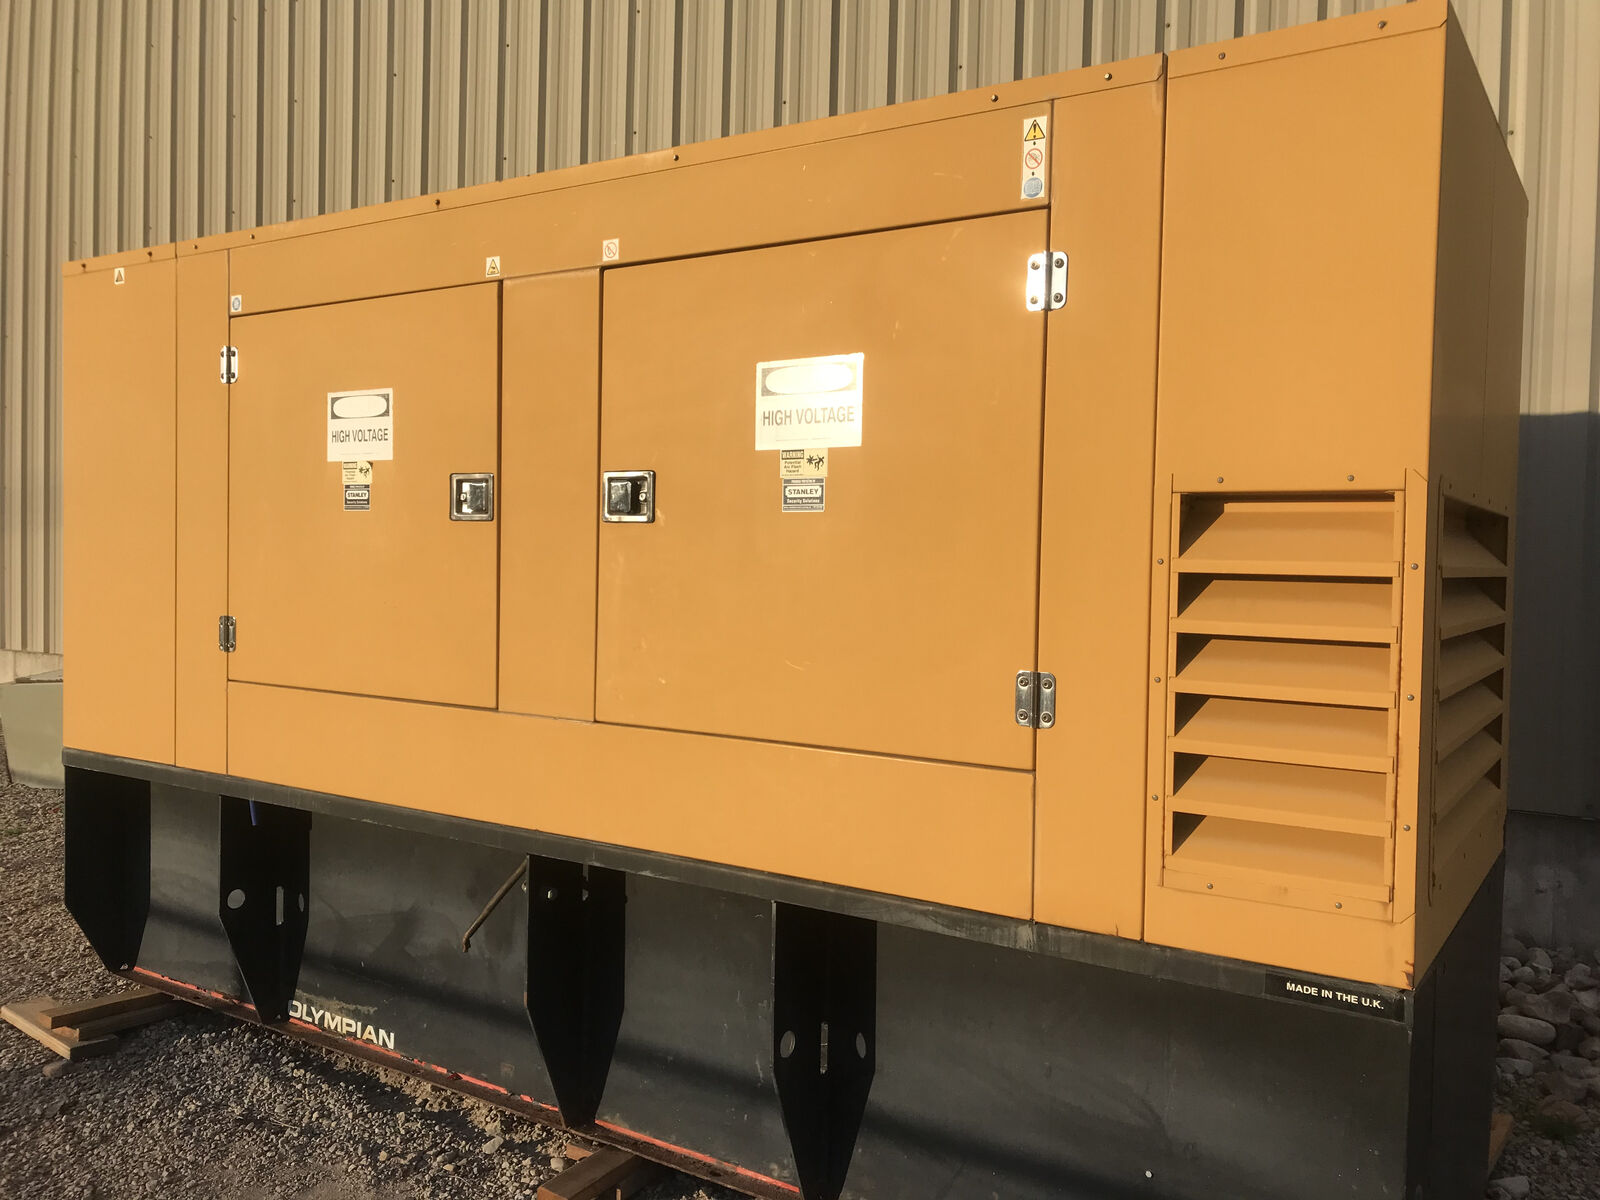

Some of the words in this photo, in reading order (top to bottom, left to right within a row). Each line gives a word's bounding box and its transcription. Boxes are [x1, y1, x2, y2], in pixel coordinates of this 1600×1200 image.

[763, 409, 792, 426] HIGH
[796, 406, 855, 425] VOLTAGE
[331, 430, 350, 443] HIGH
[352, 428, 389, 442] VOLTAGE
[787, 488, 819, 496] STANLEY
[1286, 981, 1318, 996] MADE
[1321, 989, 1333, 999] IN
[1335, 991, 1359, 1004] THE
[1361, 997, 1385, 1010] U.K.
[288, 1000, 395, 1050] OLYMPIAN
